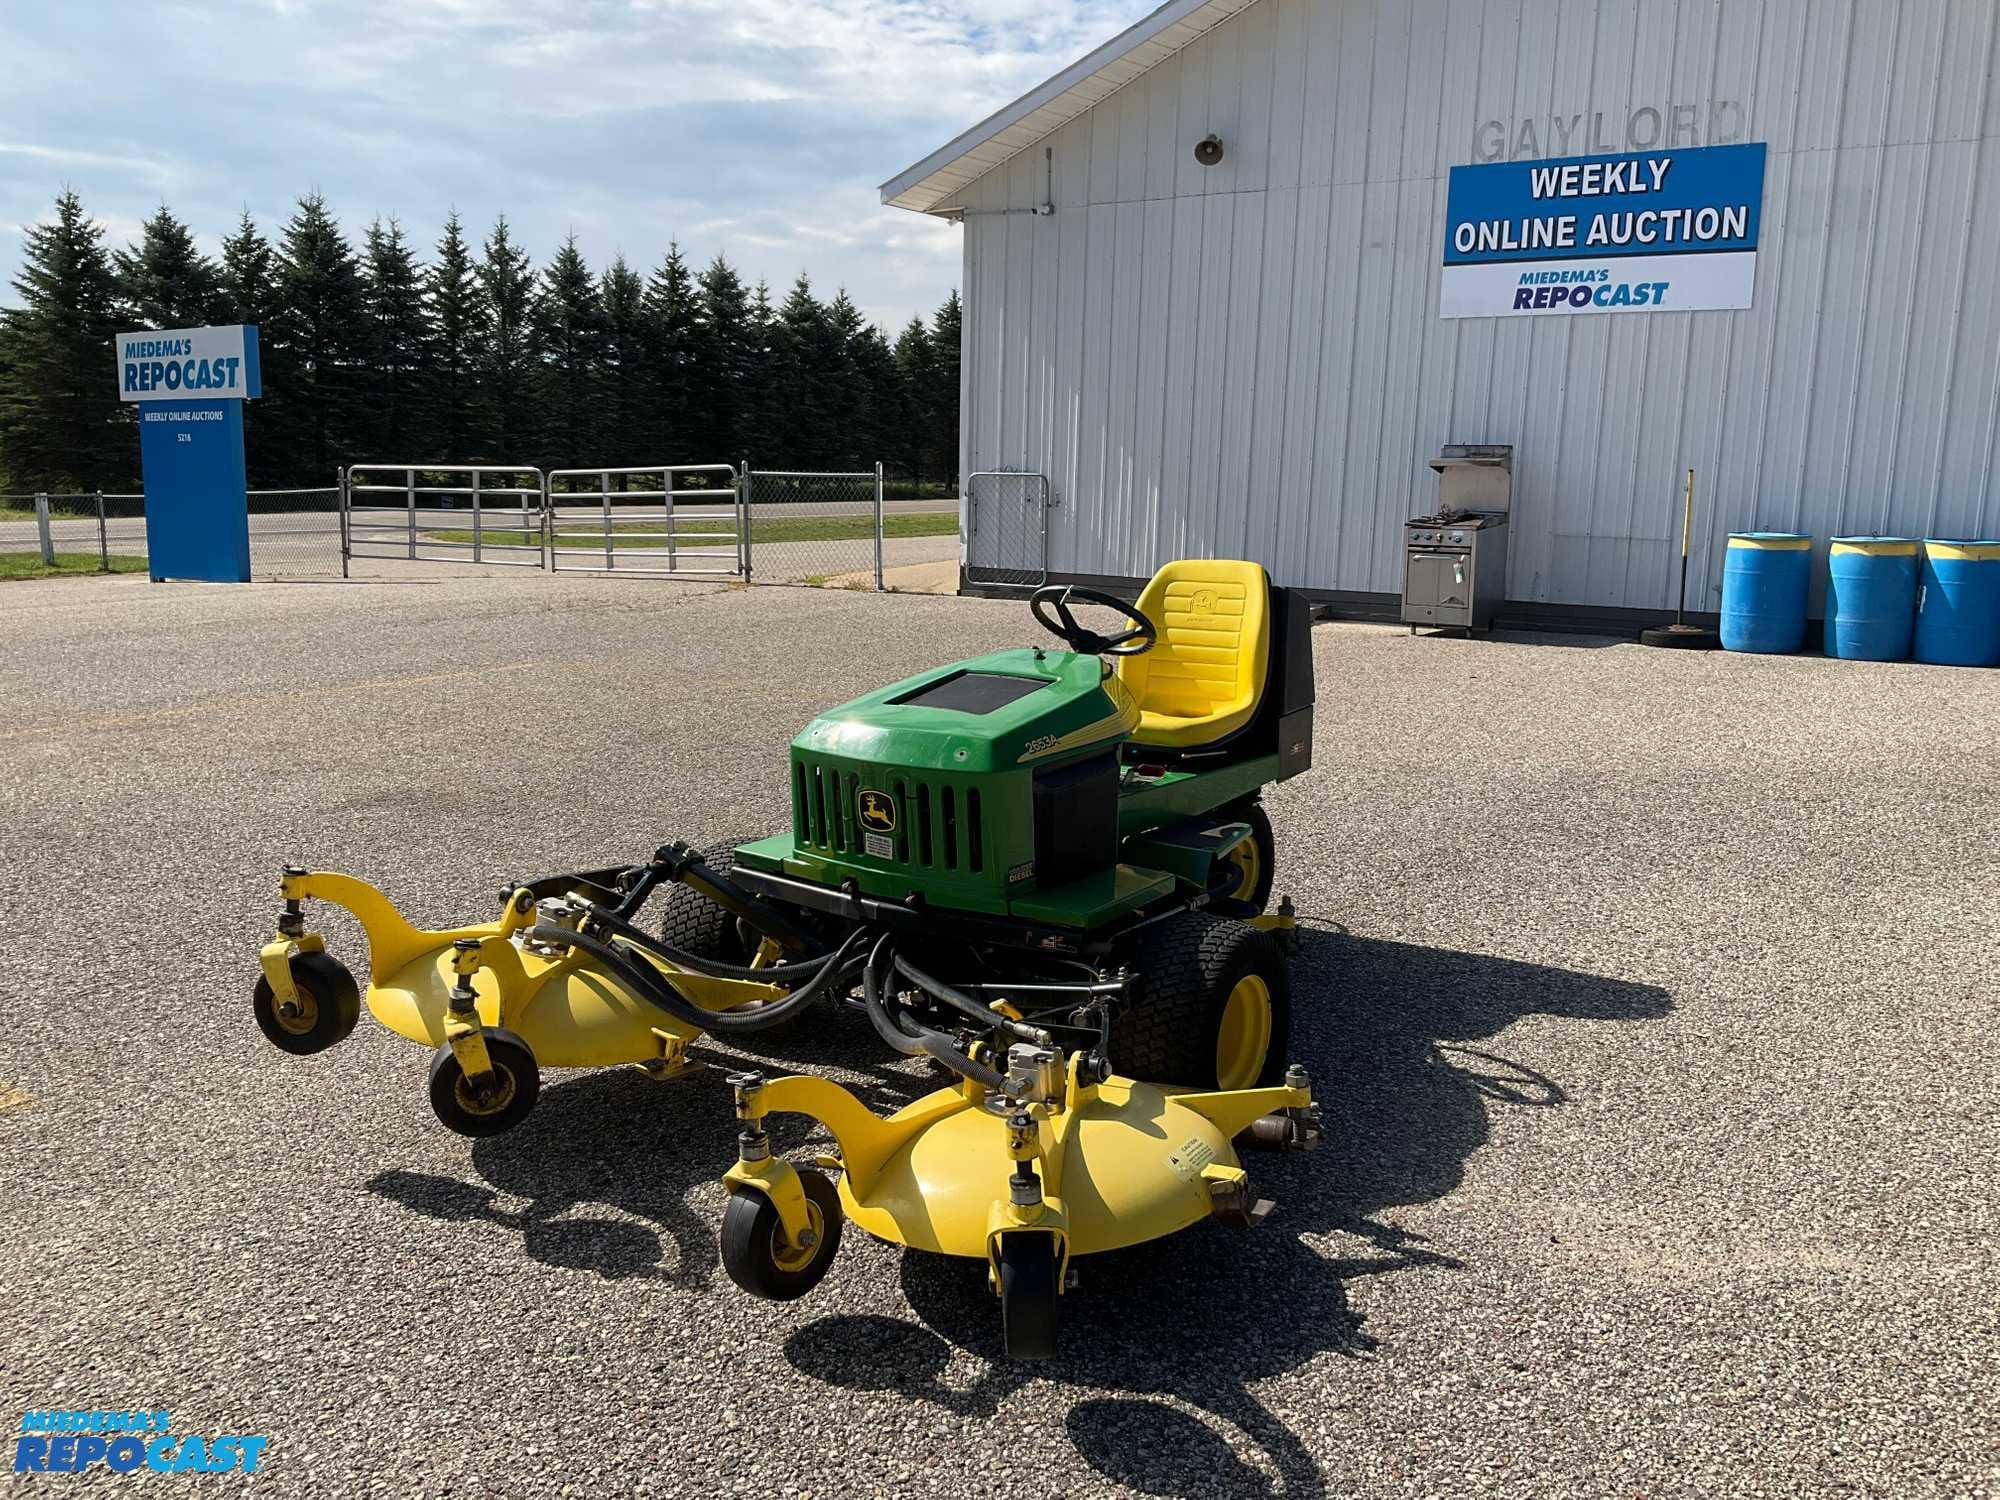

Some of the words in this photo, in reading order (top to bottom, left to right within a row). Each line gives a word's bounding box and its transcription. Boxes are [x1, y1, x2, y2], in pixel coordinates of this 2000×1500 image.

[1474, 100, 1746, 162] GAYLORD
[1530, 158, 1671, 199] WEEKLY
[1454, 216, 1576, 253] ONLINE
[1586, 206, 1748, 246] AUCTION
[1518, 269, 1609, 285] MIEDEMA'S
[1513, 282, 1669, 310] REPOCAST
[125, 339, 192, 359] MIEDEMA'S
[124, 357, 240, 392] REPOCAST
[144, 412, 168, 422] WEEKLY
[168, 411, 191, 421] ONLINE
[191, 410, 224, 421] AUCTIONS
[1025, 734, 1058, 753] 2653A
[1009, 868, 1035, 883] DIESEL
